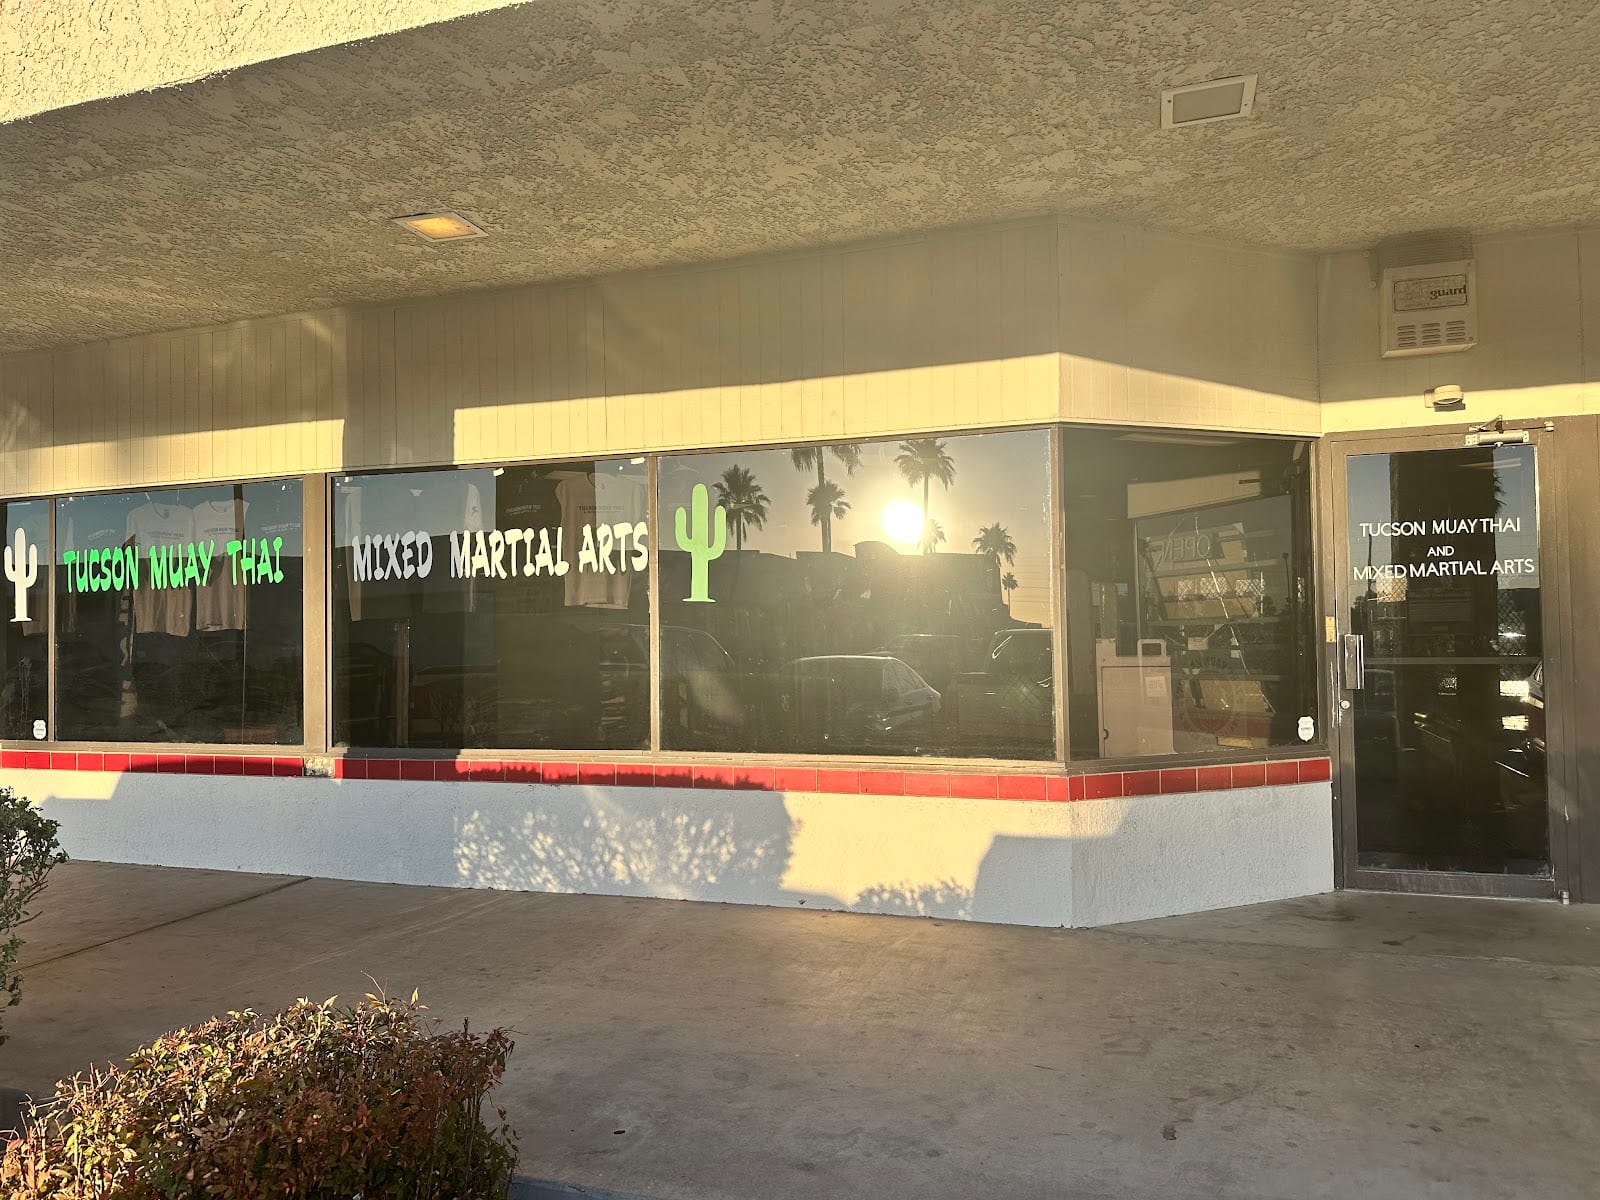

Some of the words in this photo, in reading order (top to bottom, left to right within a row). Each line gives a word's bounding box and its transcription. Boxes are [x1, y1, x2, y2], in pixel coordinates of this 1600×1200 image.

[1360, 520, 1426, 537] TUCSON
[1432, 518, 1478, 535] MUAY
[1480, 517, 1521, 533] THAI
[352, 530, 434, 582] MIXED
[449, 526, 570, 580] MARTIAL
[578, 521, 649, 575] ARTS
[1426, 545, 1455, 557] AND
[63, 545, 140, 593] TUCSON
[149, 539, 215, 590] MUAY
[226, 536, 285, 586] THAI
[1353, 564, 1407, 580] MIXED
[1409, 560, 1488, 578] MARTIAL
[1490, 558, 1536, 575] ARTS
